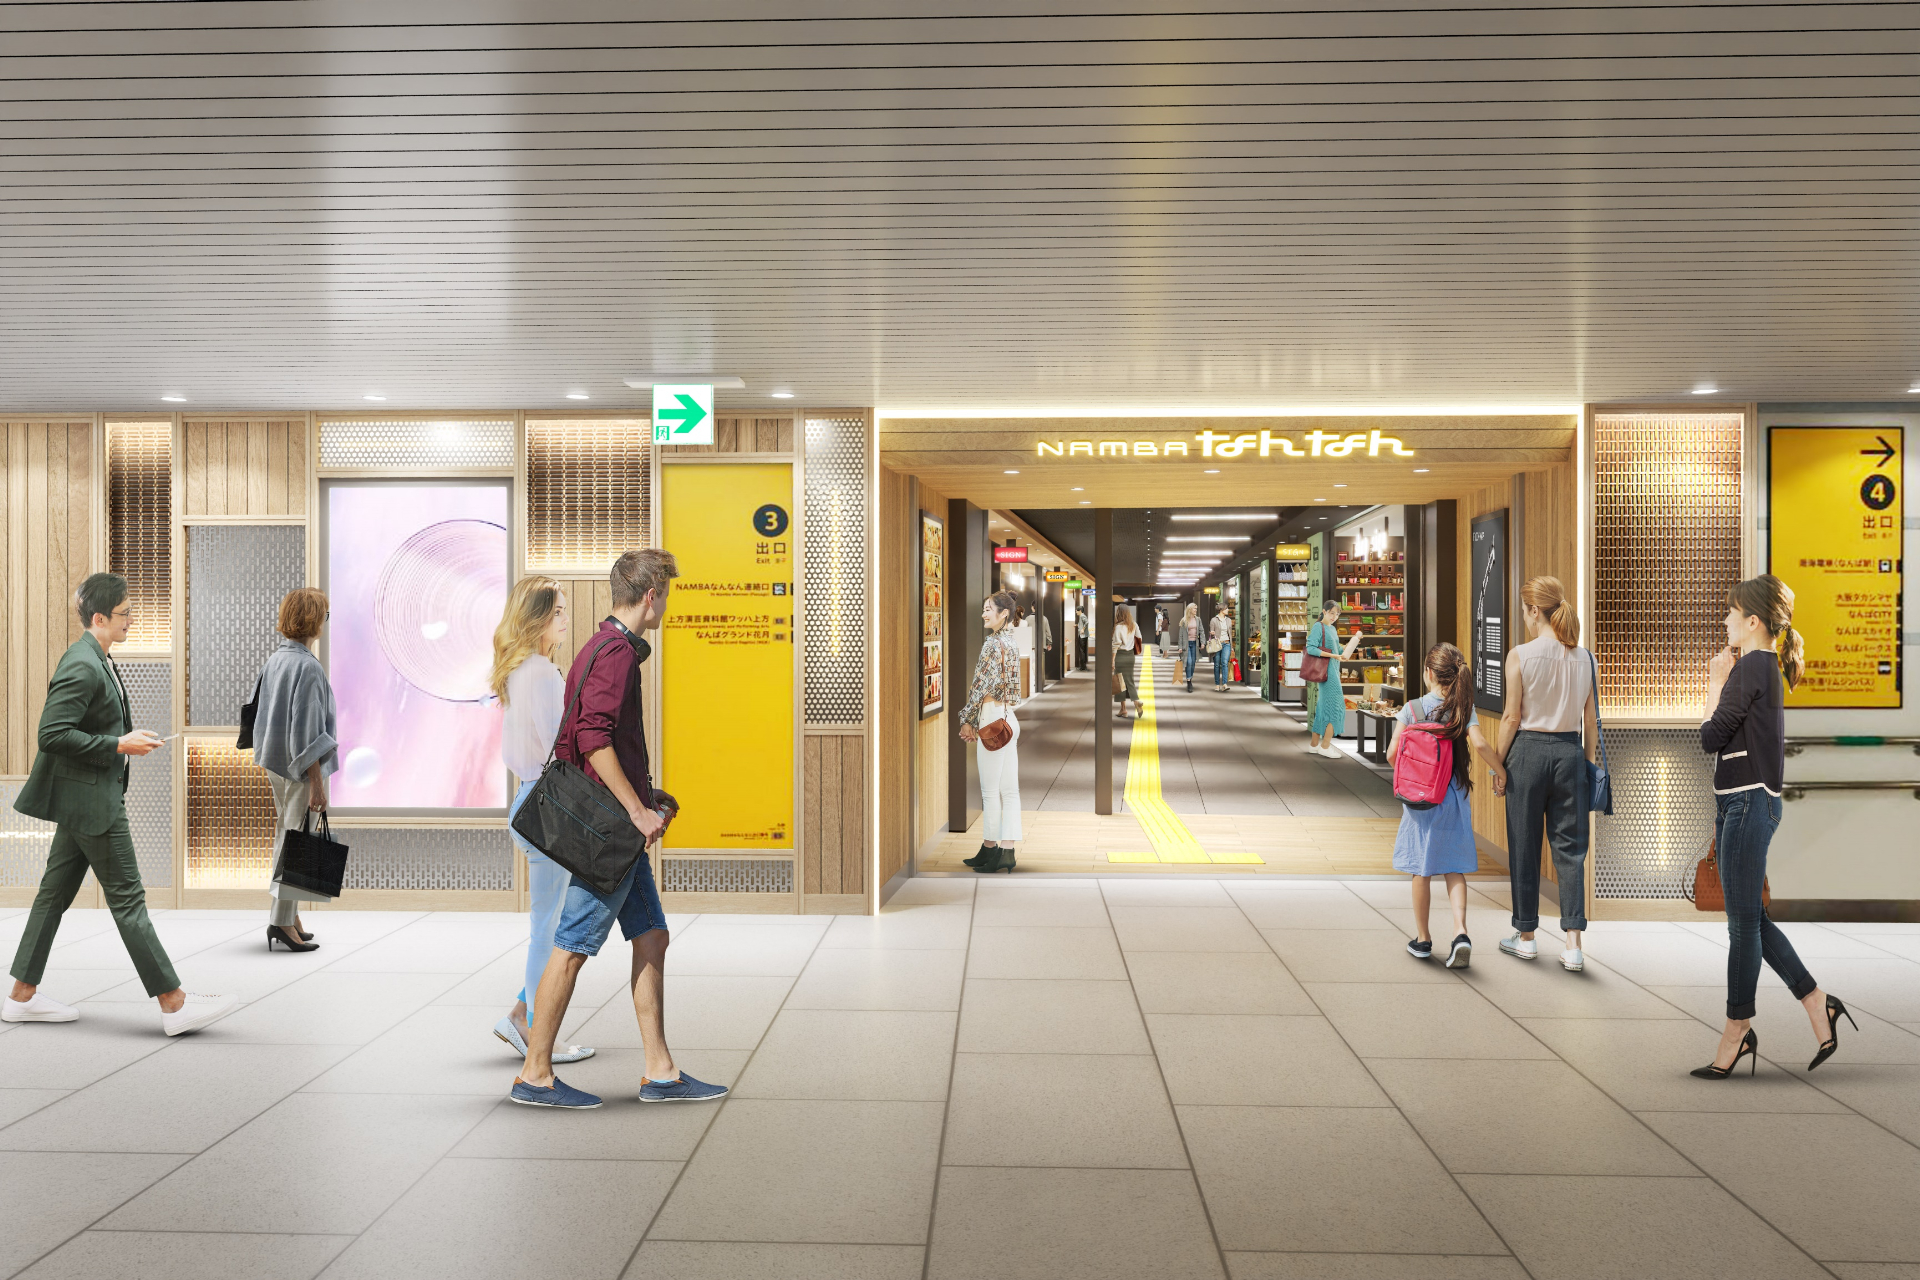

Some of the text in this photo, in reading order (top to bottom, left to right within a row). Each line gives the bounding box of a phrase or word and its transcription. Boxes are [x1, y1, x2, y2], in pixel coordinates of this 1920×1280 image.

[1037, 441, 1188, 456] NAMBA
[1870, 482, 1885, 502] 4
[765, 511, 778, 530] 3
[1863, 515, 1892, 528] 出口
[756, 541, 786, 555] 出口
[1282, 548, 1304, 556] SIGN
[696, 631, 770, 639] なんばグランド花月
